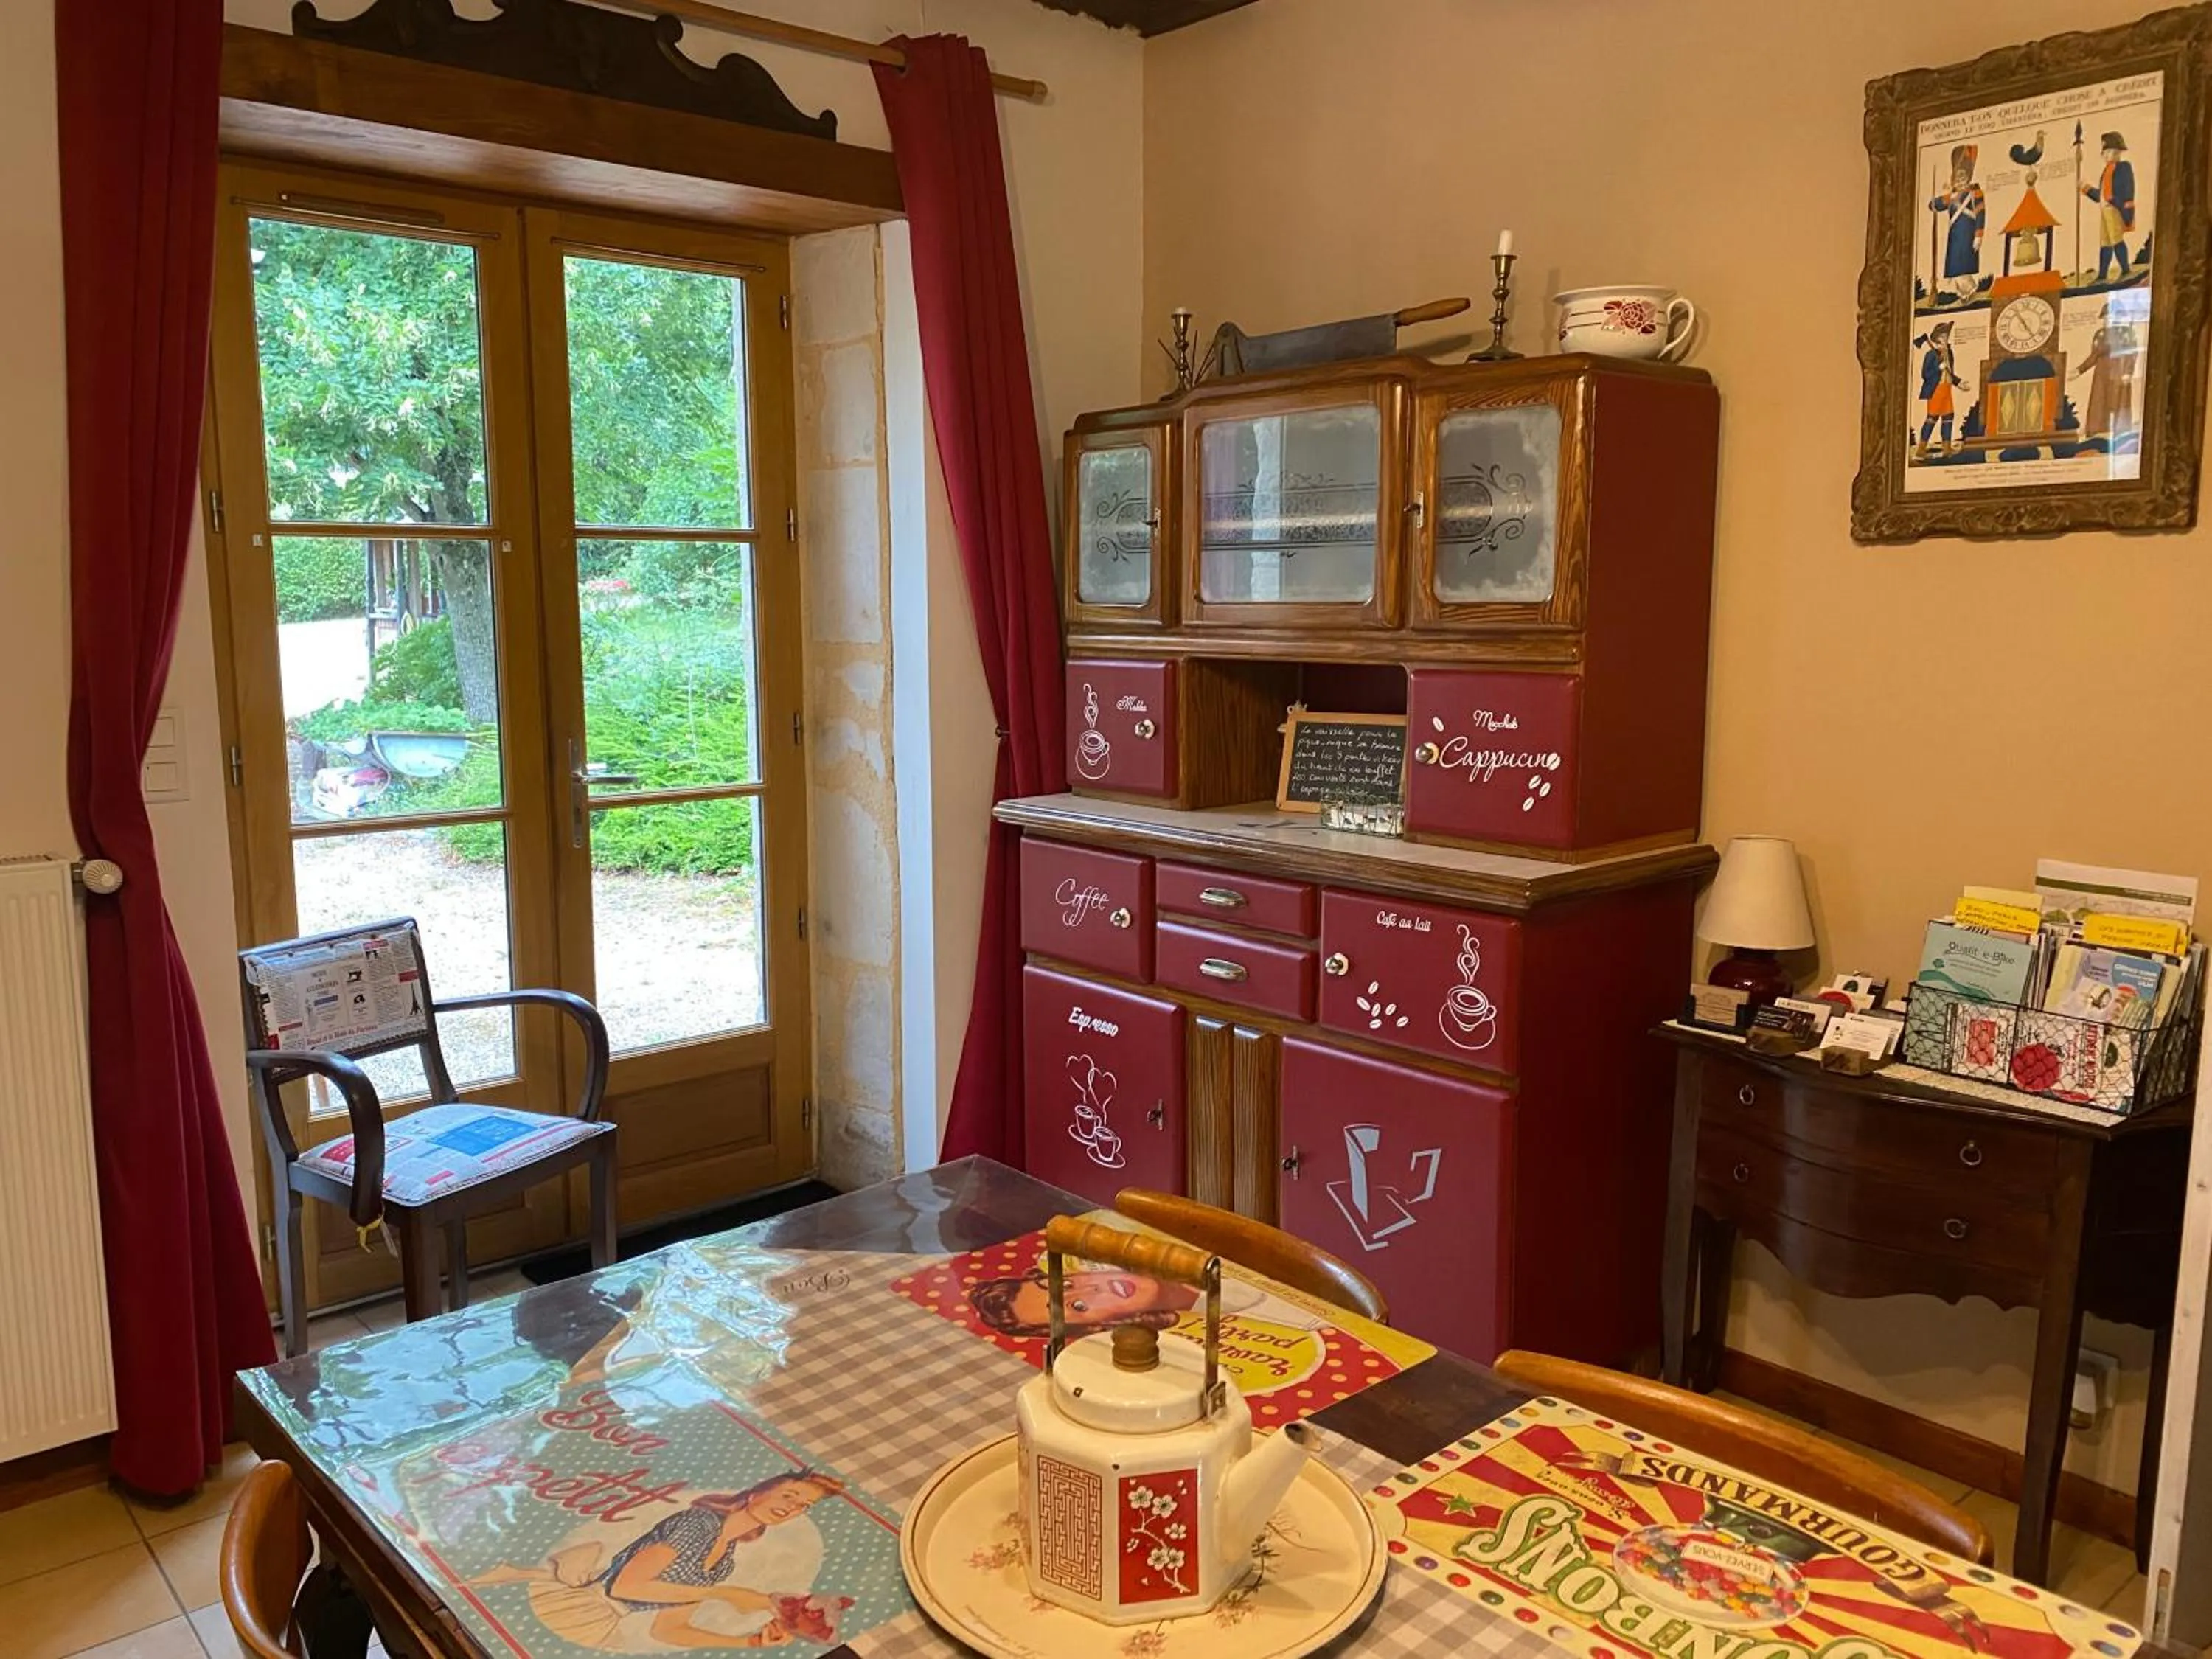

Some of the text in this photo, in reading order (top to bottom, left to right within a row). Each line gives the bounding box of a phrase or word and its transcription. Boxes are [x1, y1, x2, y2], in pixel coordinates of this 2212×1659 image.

[1056, 878, 1109, 927] Coffee
[1068, 1006, 1119, 1037] Espresso
[540, 1390, 670, 1456] Bon
[1641, 1456, 1927, 1582] GOURMANDS
